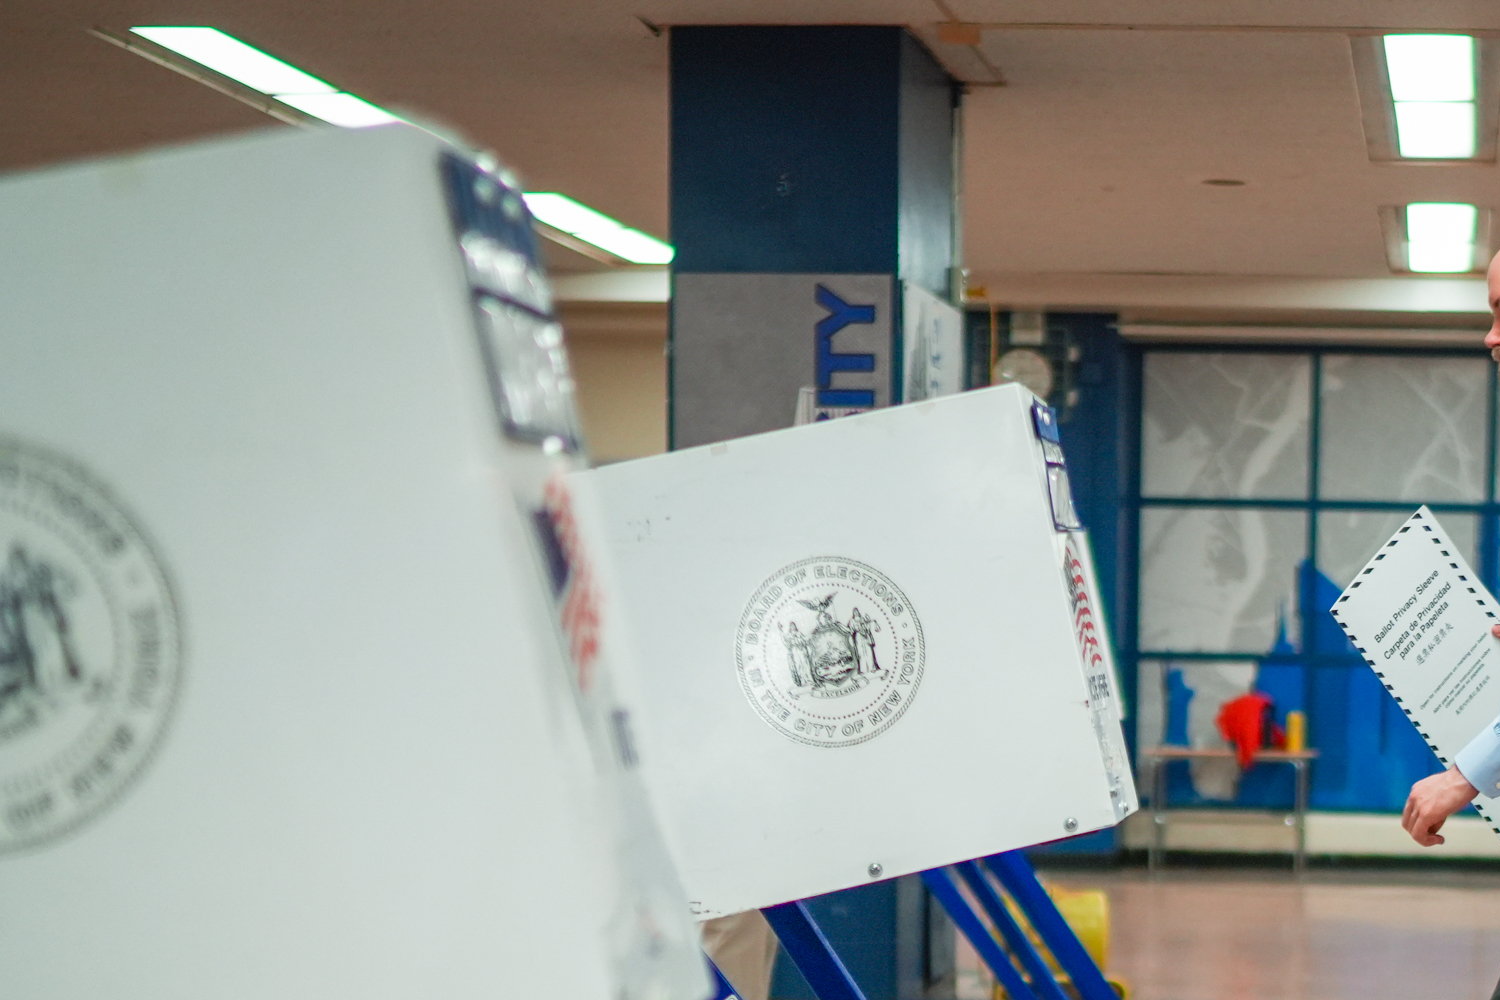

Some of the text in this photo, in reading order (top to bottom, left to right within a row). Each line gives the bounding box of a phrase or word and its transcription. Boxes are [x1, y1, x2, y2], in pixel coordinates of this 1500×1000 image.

[814, 283, 876, 421] ITY
[746, 565, 904, 645] BOARD OF ELECTIONS
[1374, 569, 1439, 644] Ballot Privacy Sleeve
[1383, 581, 1452, 660] Carpeta de Privacidad
[1399, 601, 1449, 660] para la Papeleta
[747, 636, 916, 738] IN THE CITY OF NEW YORK
